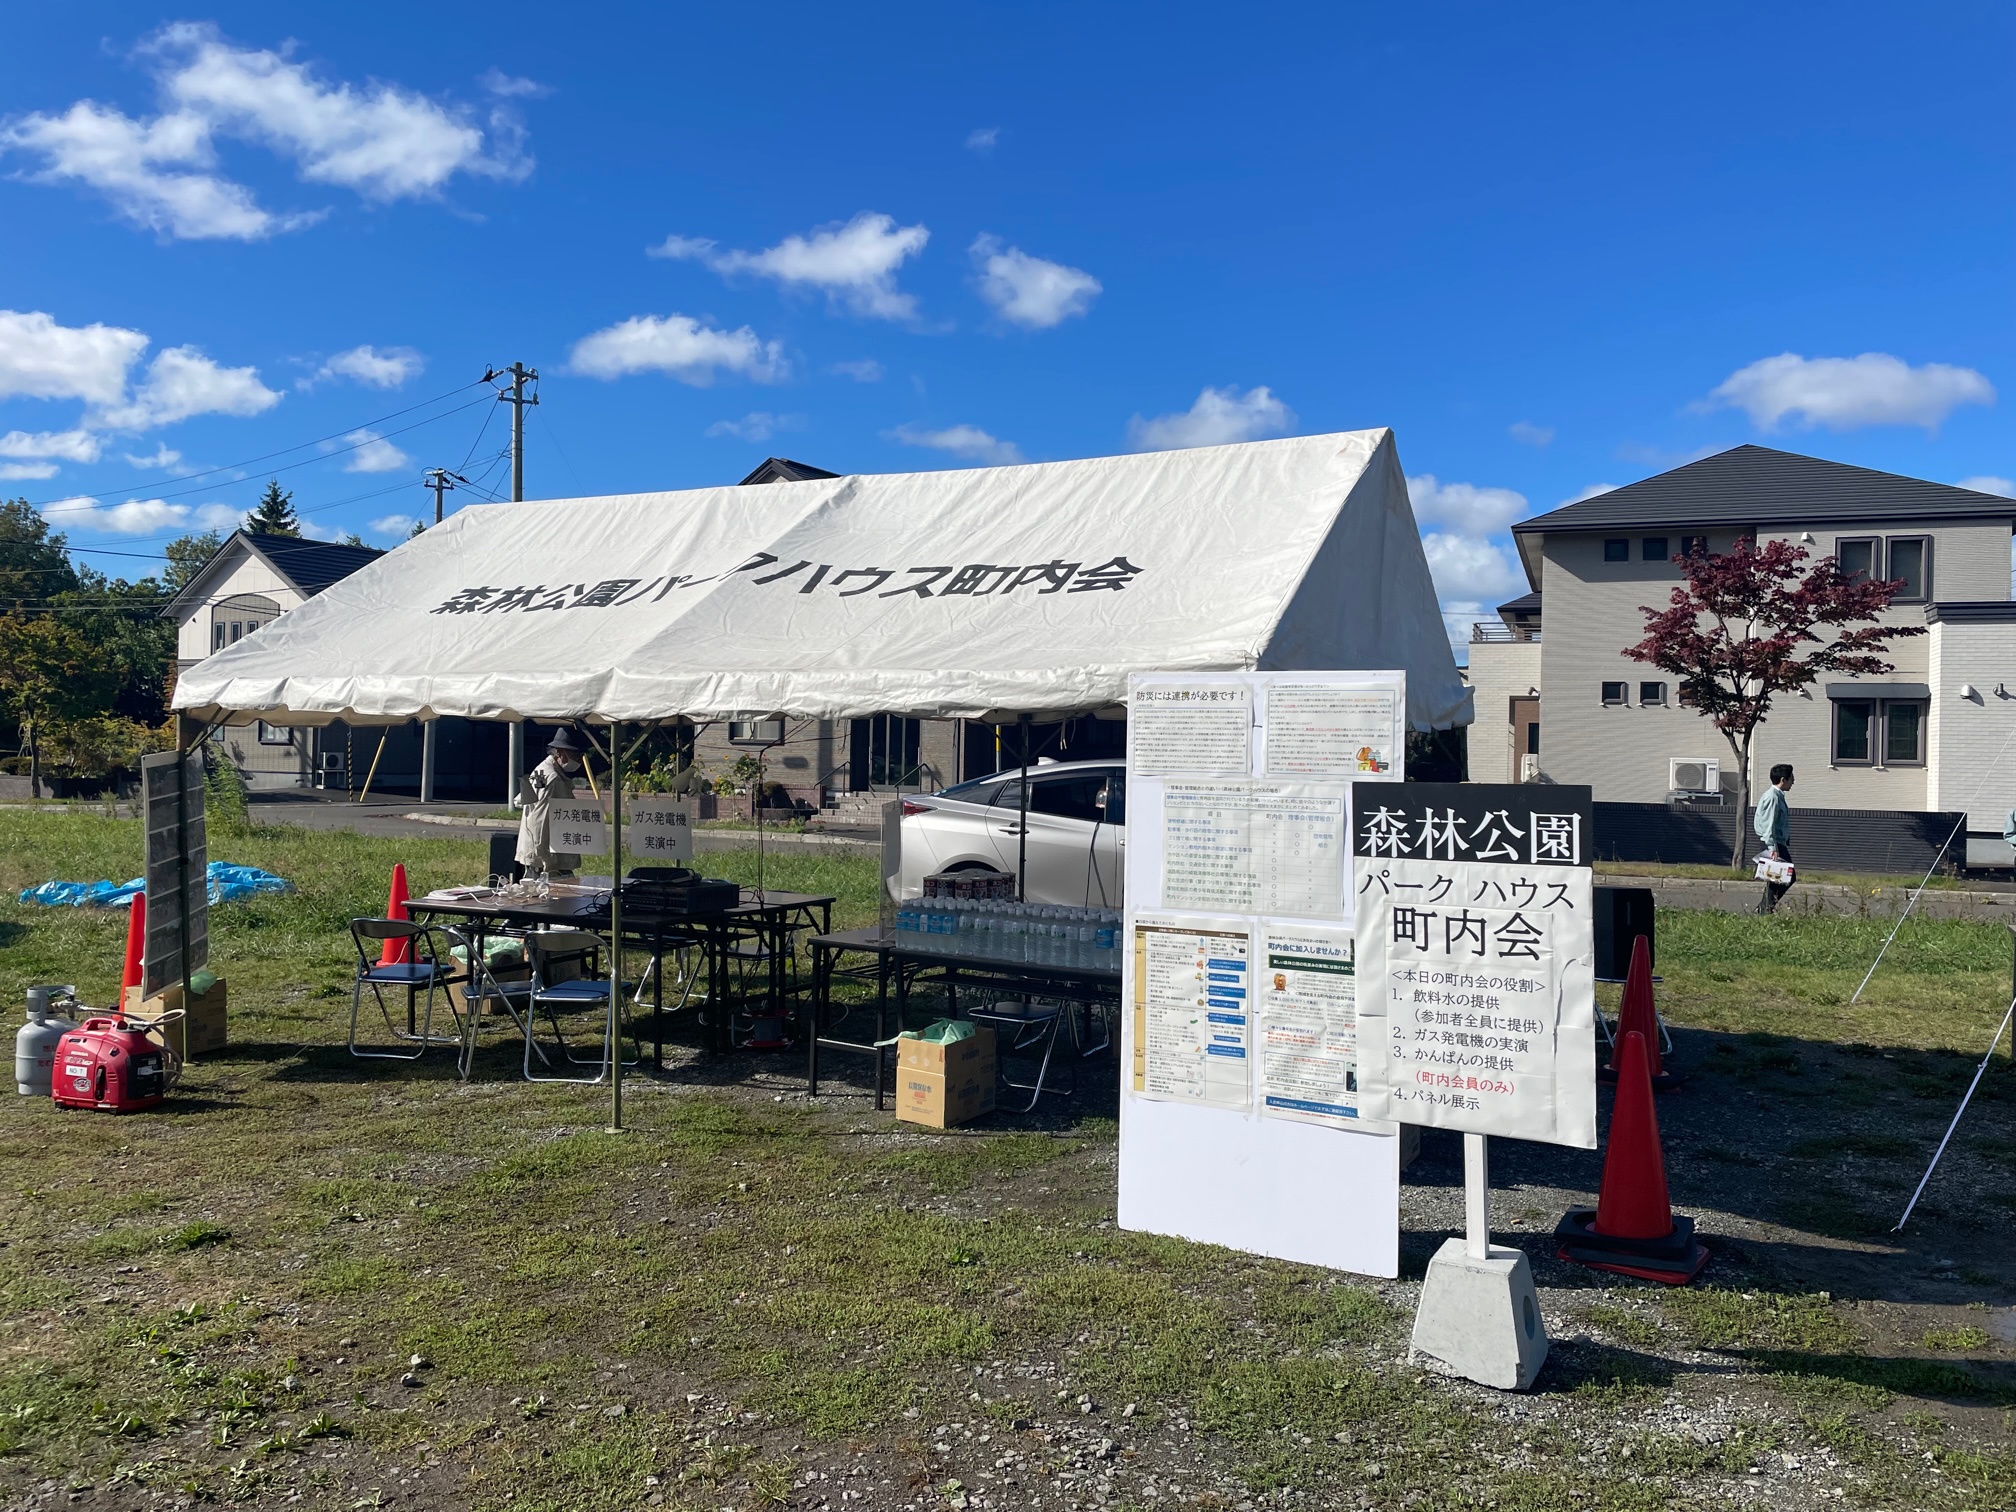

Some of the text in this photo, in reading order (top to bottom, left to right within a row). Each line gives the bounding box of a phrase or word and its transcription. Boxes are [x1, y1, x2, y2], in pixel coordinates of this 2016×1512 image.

[430, 552, 1145, 615] 森林公園パークハウス町内会
[1136, 689, 1245, 702] 防災には連携が必要です！
[553, 808, 601, 823] ガス発電機
[635, 811, 687, 827] ガス発電機
[1265, 813, 1283, 821] 町内会
[562, 832, 592, 846] 実演中
[644, 835, 676, 850] 実演中
[1360, 806, 1581, 865] 森林公園
[1393, 906, 1544, 961] 町内会
[1267, 942, 1348, 957] 町内会に加入しませんか？
[1413, 988, 1500, 1010] 飲料水の提供
[1415, 1009, 1544, 1035] （参加者全員に提供）
[1414, 1028, 1529, 1053] ガス発電機の実演
[1415, 1048, 1514, 1071] かんぱんの提供
[1416, 1070, 1515, 1095] （町内会員のみ）
[1412, 1090, 1480, 1110] パネル展示
